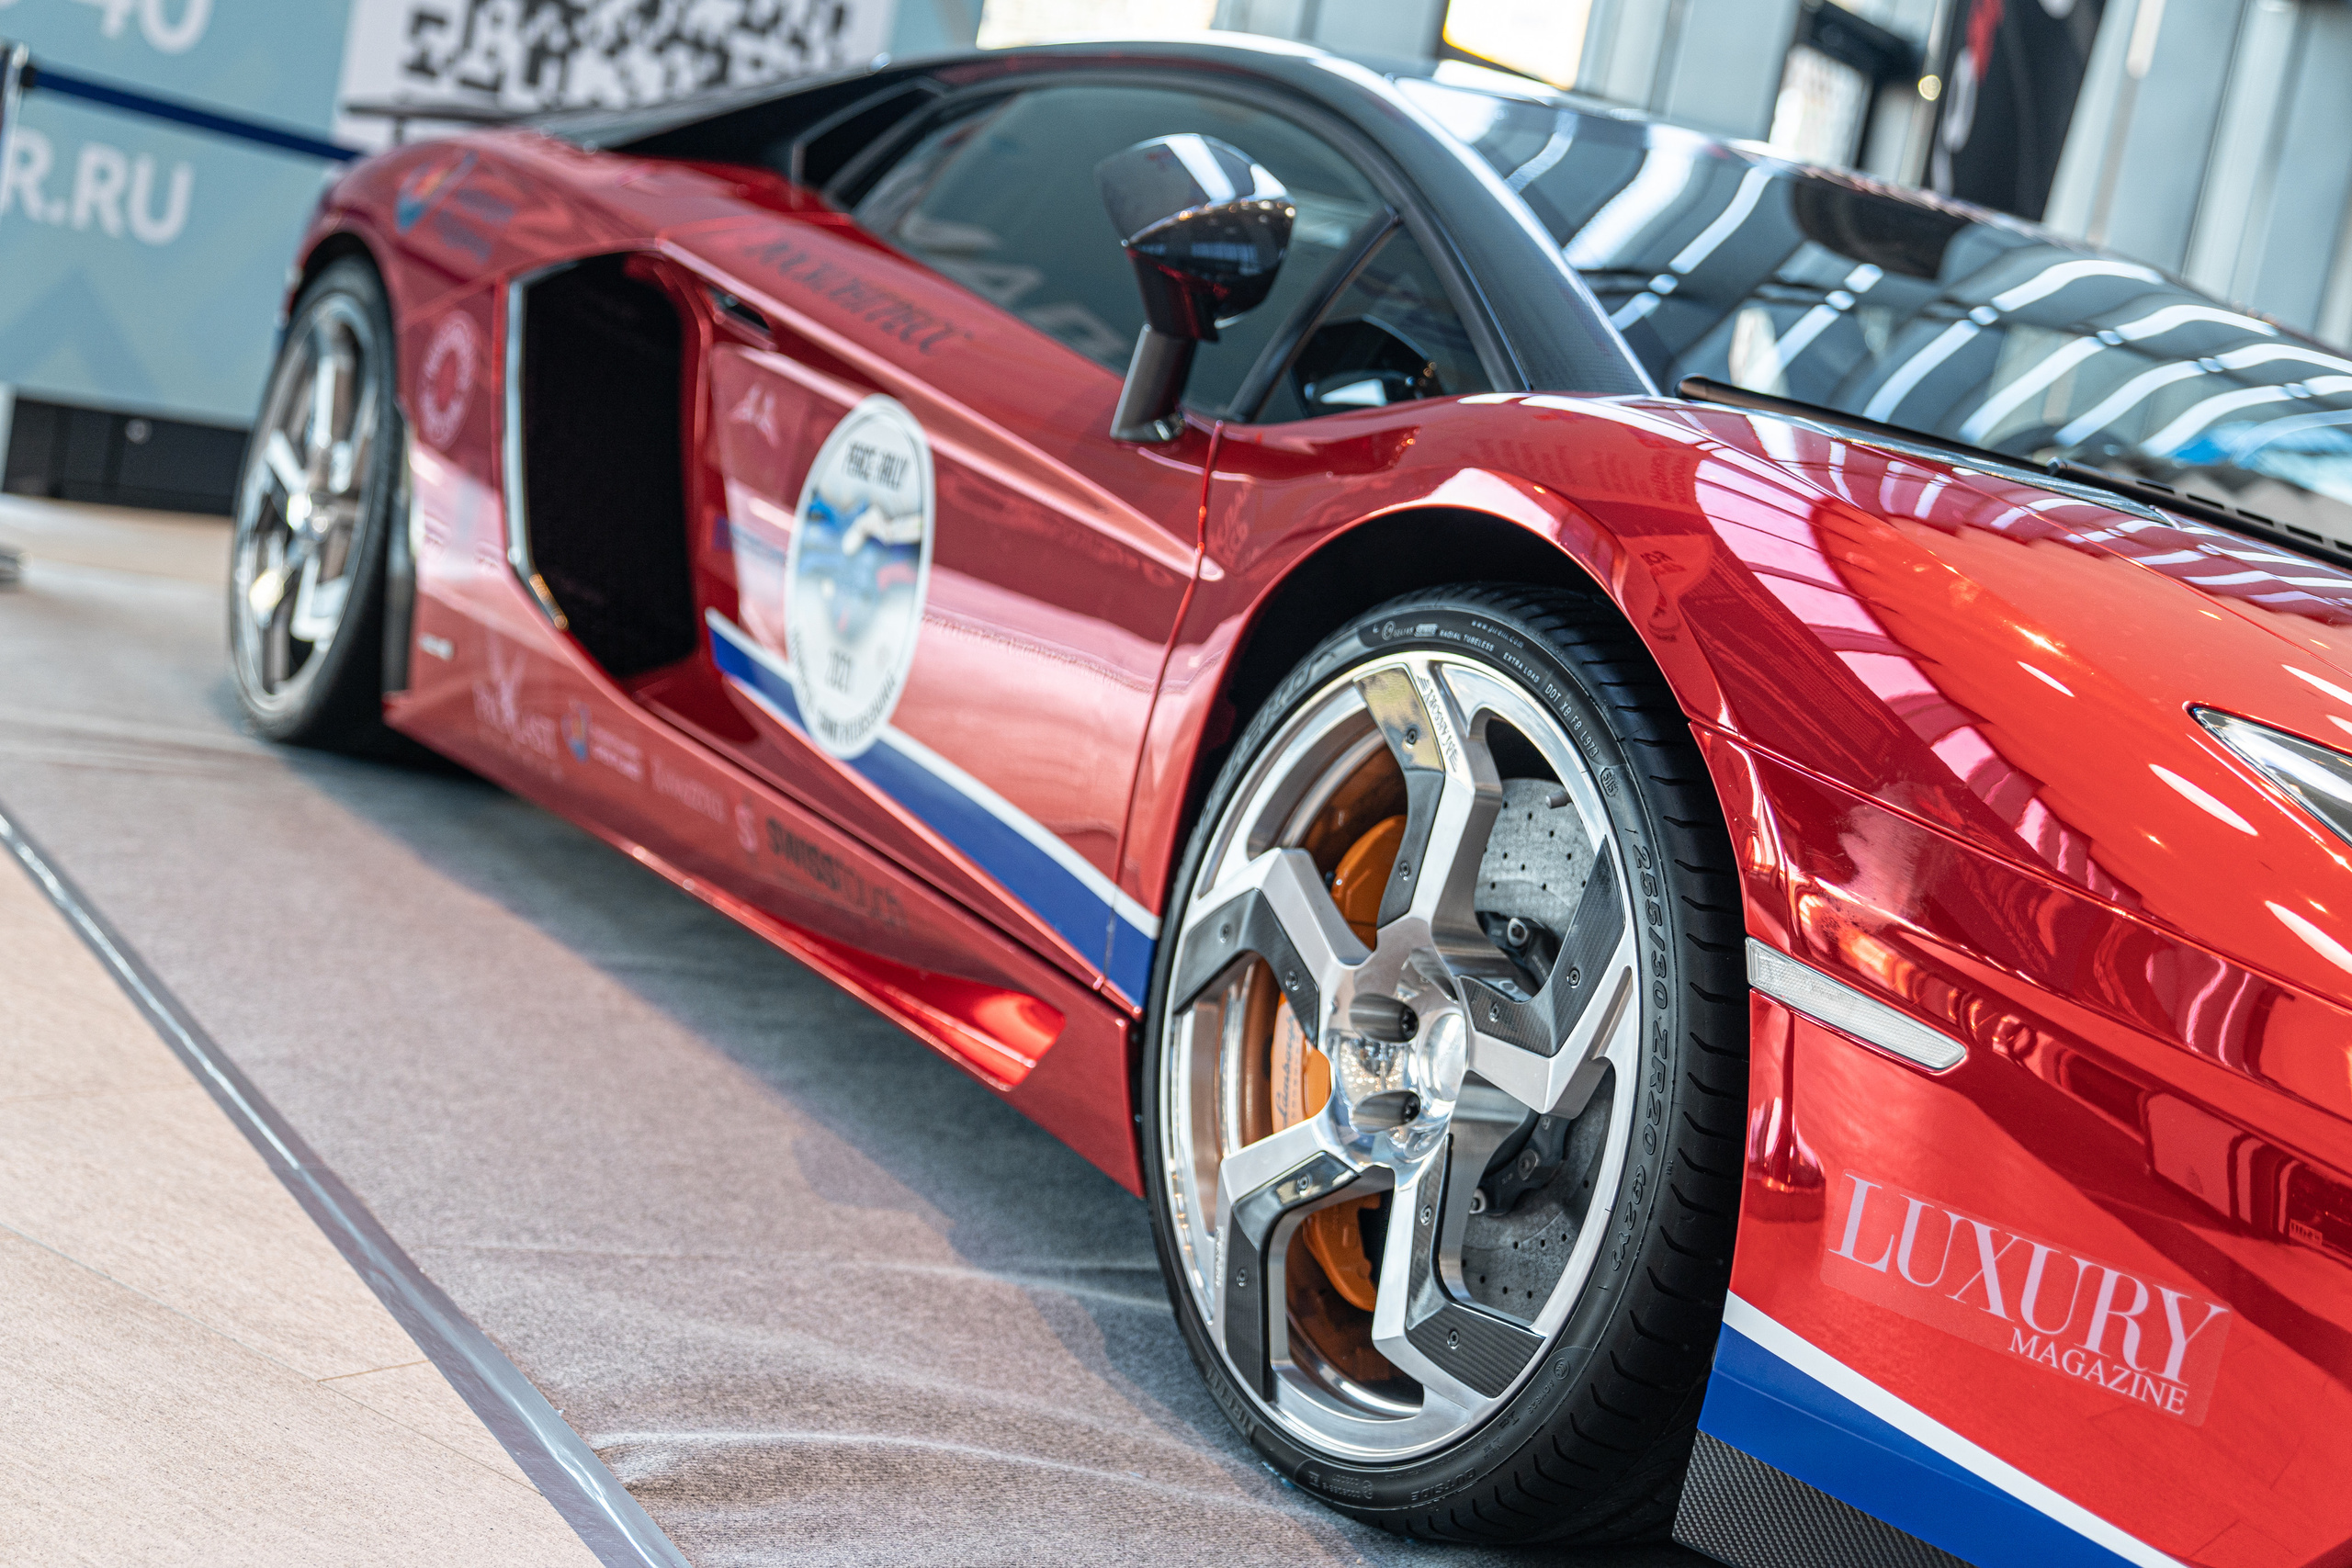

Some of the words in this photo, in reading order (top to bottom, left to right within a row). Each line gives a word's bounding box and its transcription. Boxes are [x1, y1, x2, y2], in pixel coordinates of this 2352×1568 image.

[1439, 629, 1461, 641] RADIAL
[1464, 634, 1495, 652] TUBELESS
[1503, 652, 1523, 671] EXTRA
[1522, 666, 1541, 683] LOAD
[1544, 682, 1562, 704] DOT
[1559, 701, 1573, 717] XB
[1569, 716, 1582, 731] F8
[1579, 730, 1600, 758] L973
[1632, 844, 1668, 1010] 255/30
[1642, 1020, 1668, 1156] ZR20
[1828, 1173, 2230, 1386] LUXURY
[2007, 1327, 2188, 1416] MAGAZINE
[1410, 1467, 1476, 1501] OUTSIDE
